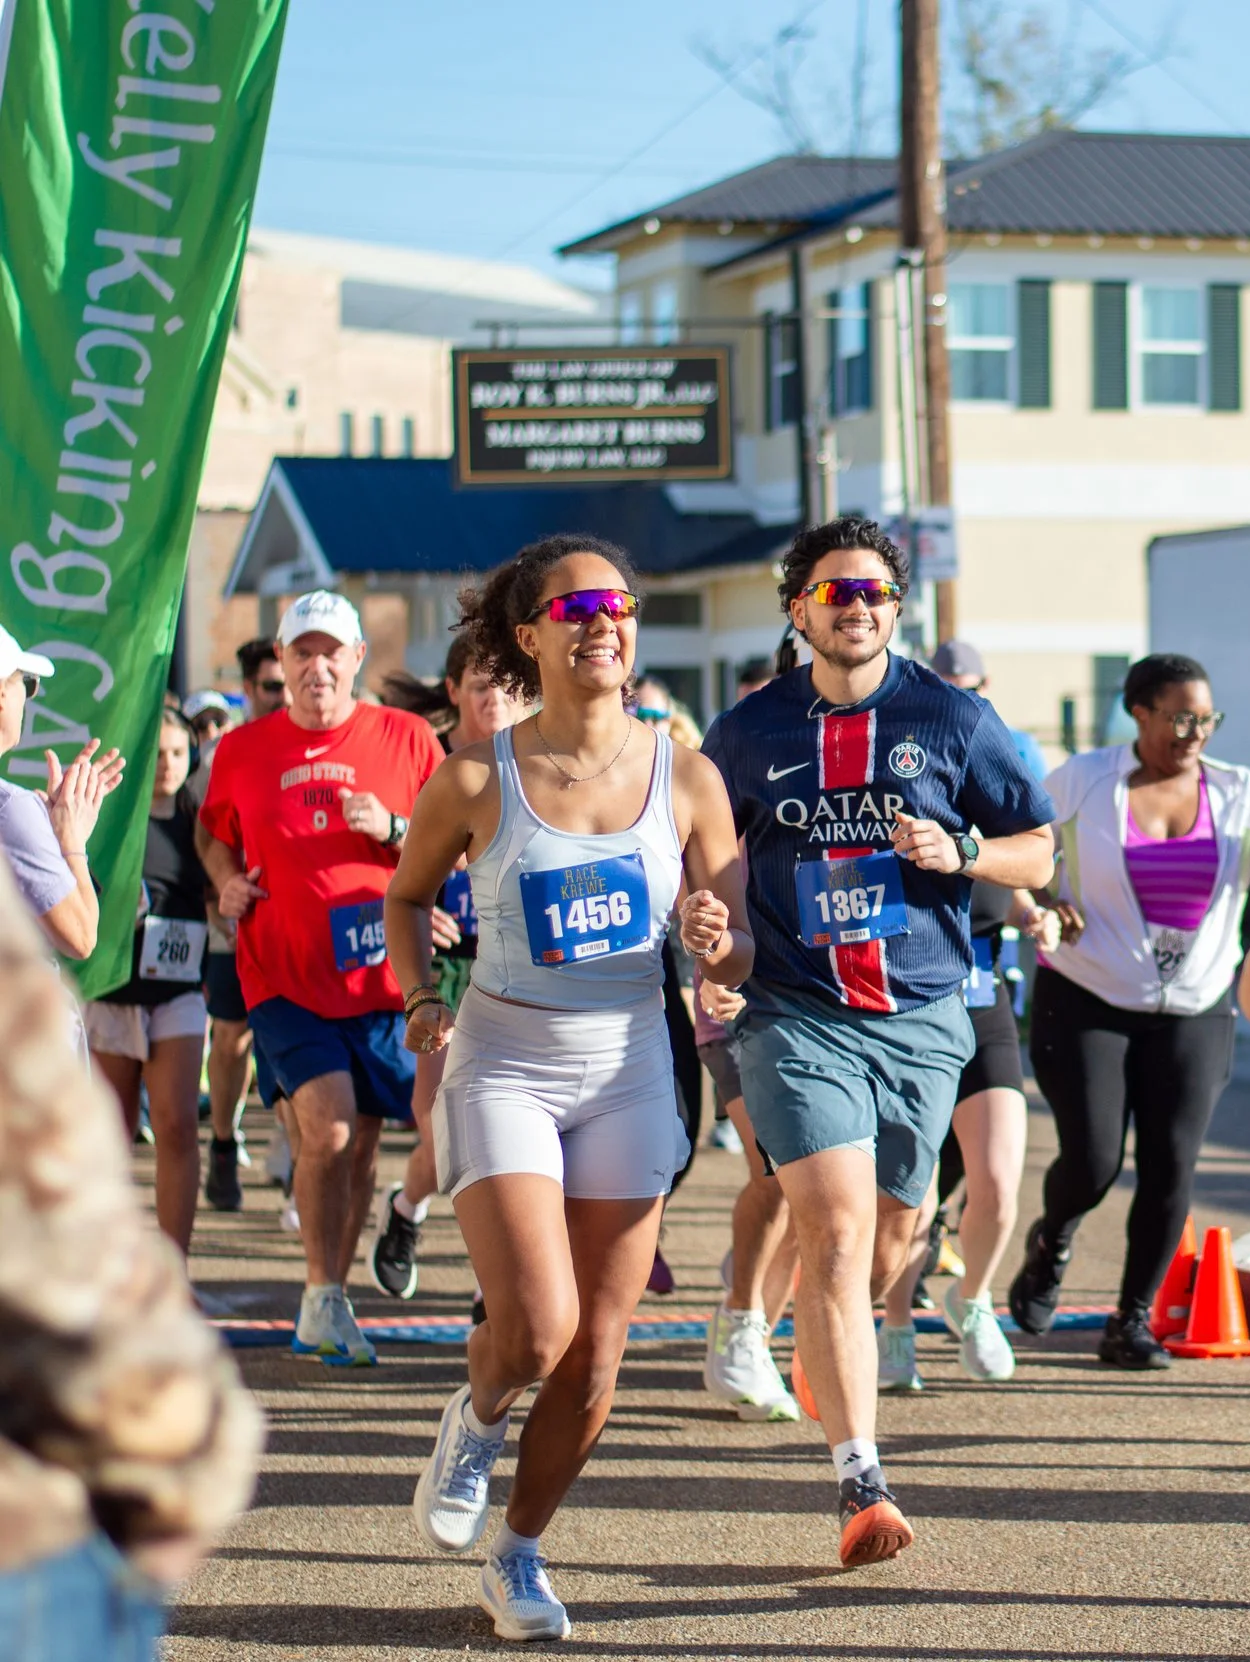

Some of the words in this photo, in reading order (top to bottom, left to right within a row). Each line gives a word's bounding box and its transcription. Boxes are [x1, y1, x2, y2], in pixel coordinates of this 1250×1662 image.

[77, 0, 222, 213] elly
[554, 381, 634, 406] BURNS
[11, 228, 183, 616] Kicking
[485, 419, 619, 447] MARGARET
[622, 418, 705, 444] BURNS
[895, 744, 920, 754] PARIS
[280, 765, 312, 791] OHIO
[312, 762, 356, 785] STATE
[303, 788, 334, 807] 1870
[776, 792, 904, 830] QATAR
[809, 822, 901, 842] AIRWAY
[564, 864, 600, 884] RACE
[561, 878, 608, 900] KREWE
[814, 883, 886, 923] 1367
[544, 890, 632, 939] 1456
